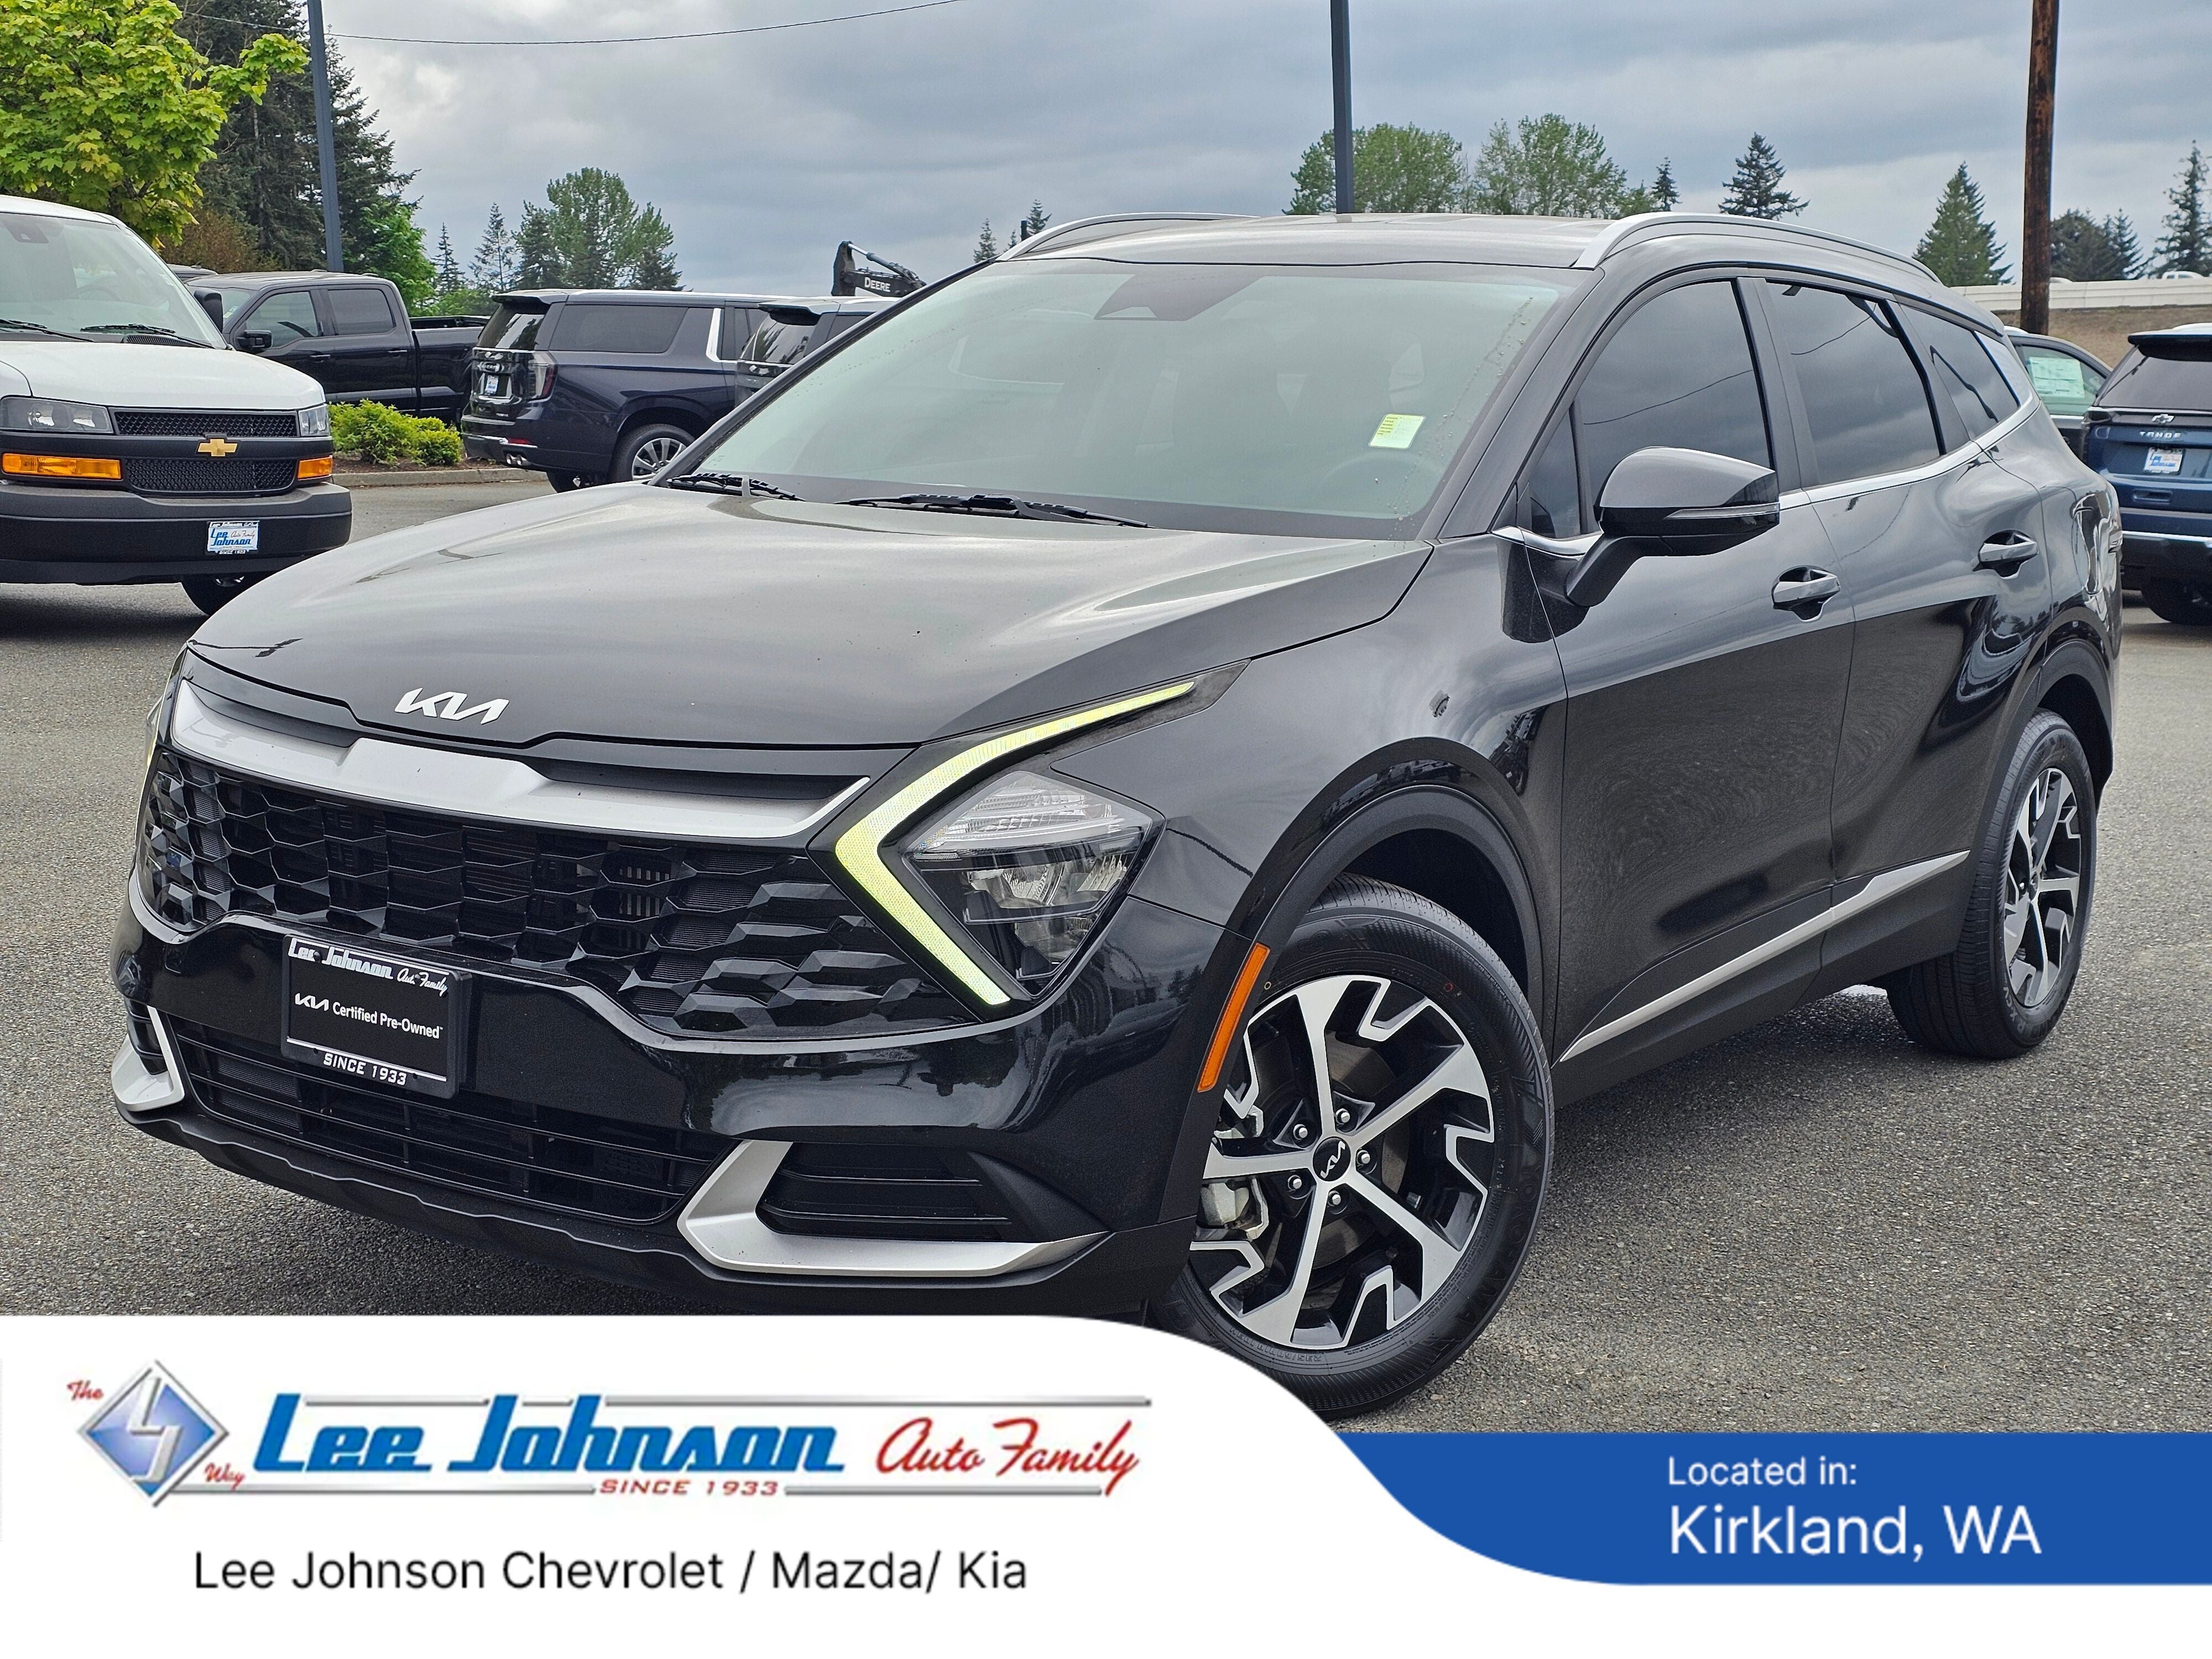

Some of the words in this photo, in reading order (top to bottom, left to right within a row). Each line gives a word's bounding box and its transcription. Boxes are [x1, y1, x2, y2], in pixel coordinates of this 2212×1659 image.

[864, 276, 891, 293] DEERE
[211, 528, 229, 538] Lee
[211, 536, 252, 546] Johnson
[394, 687, 510, 725] KIA
[322, 946, 394, 979] Johnson
[397, 968, 418, 985] Aut
[419, 972, 448, 997] Family
[295, 993, 329, 1011] KIA
[332, 1001, 377, 1024] Certified
[323, 1053, 366, 1075] SINCE
[372, 1065, 407, 1086] 1933
